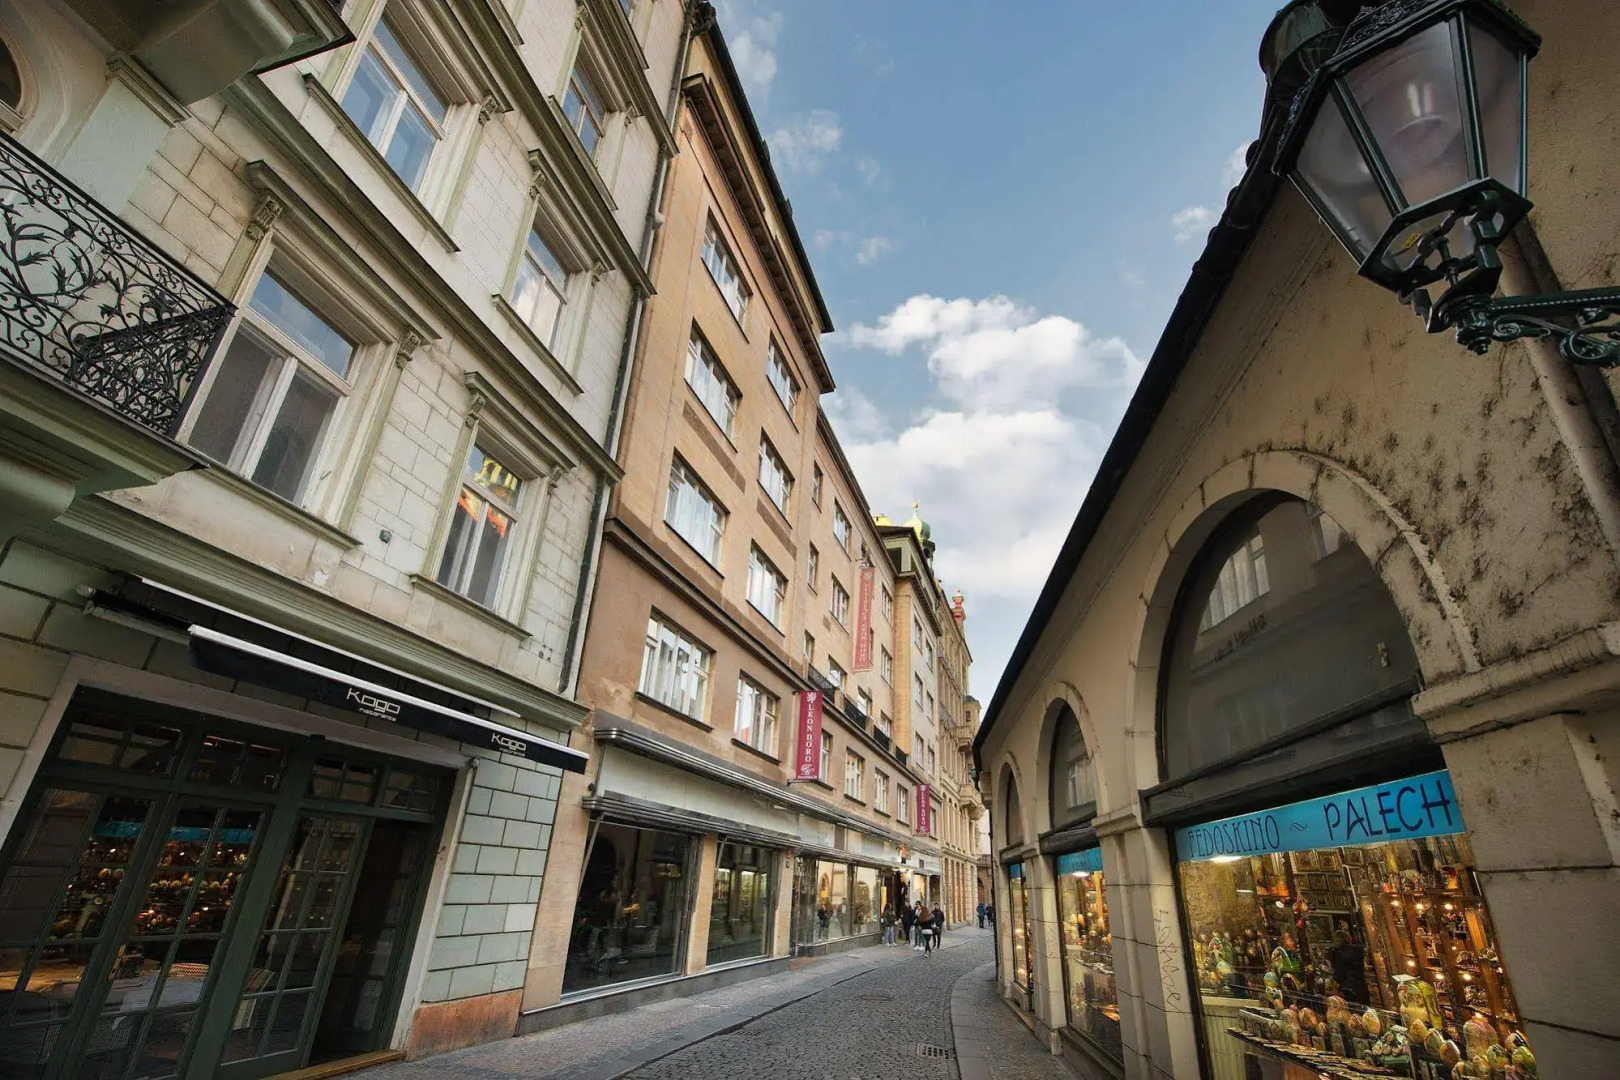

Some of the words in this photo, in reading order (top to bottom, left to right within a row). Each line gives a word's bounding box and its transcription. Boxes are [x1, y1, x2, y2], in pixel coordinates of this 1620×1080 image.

[346, 688, 400, 714] Kogo
[806, 703, 814, 732] LEON
[491, 732, 527, 751] Kogo
[805, 733, 813, 763] DORO
[1187, 814, 1281, 857] FEDOSKINO
[1323, 780, 1451, 841] PALECH
